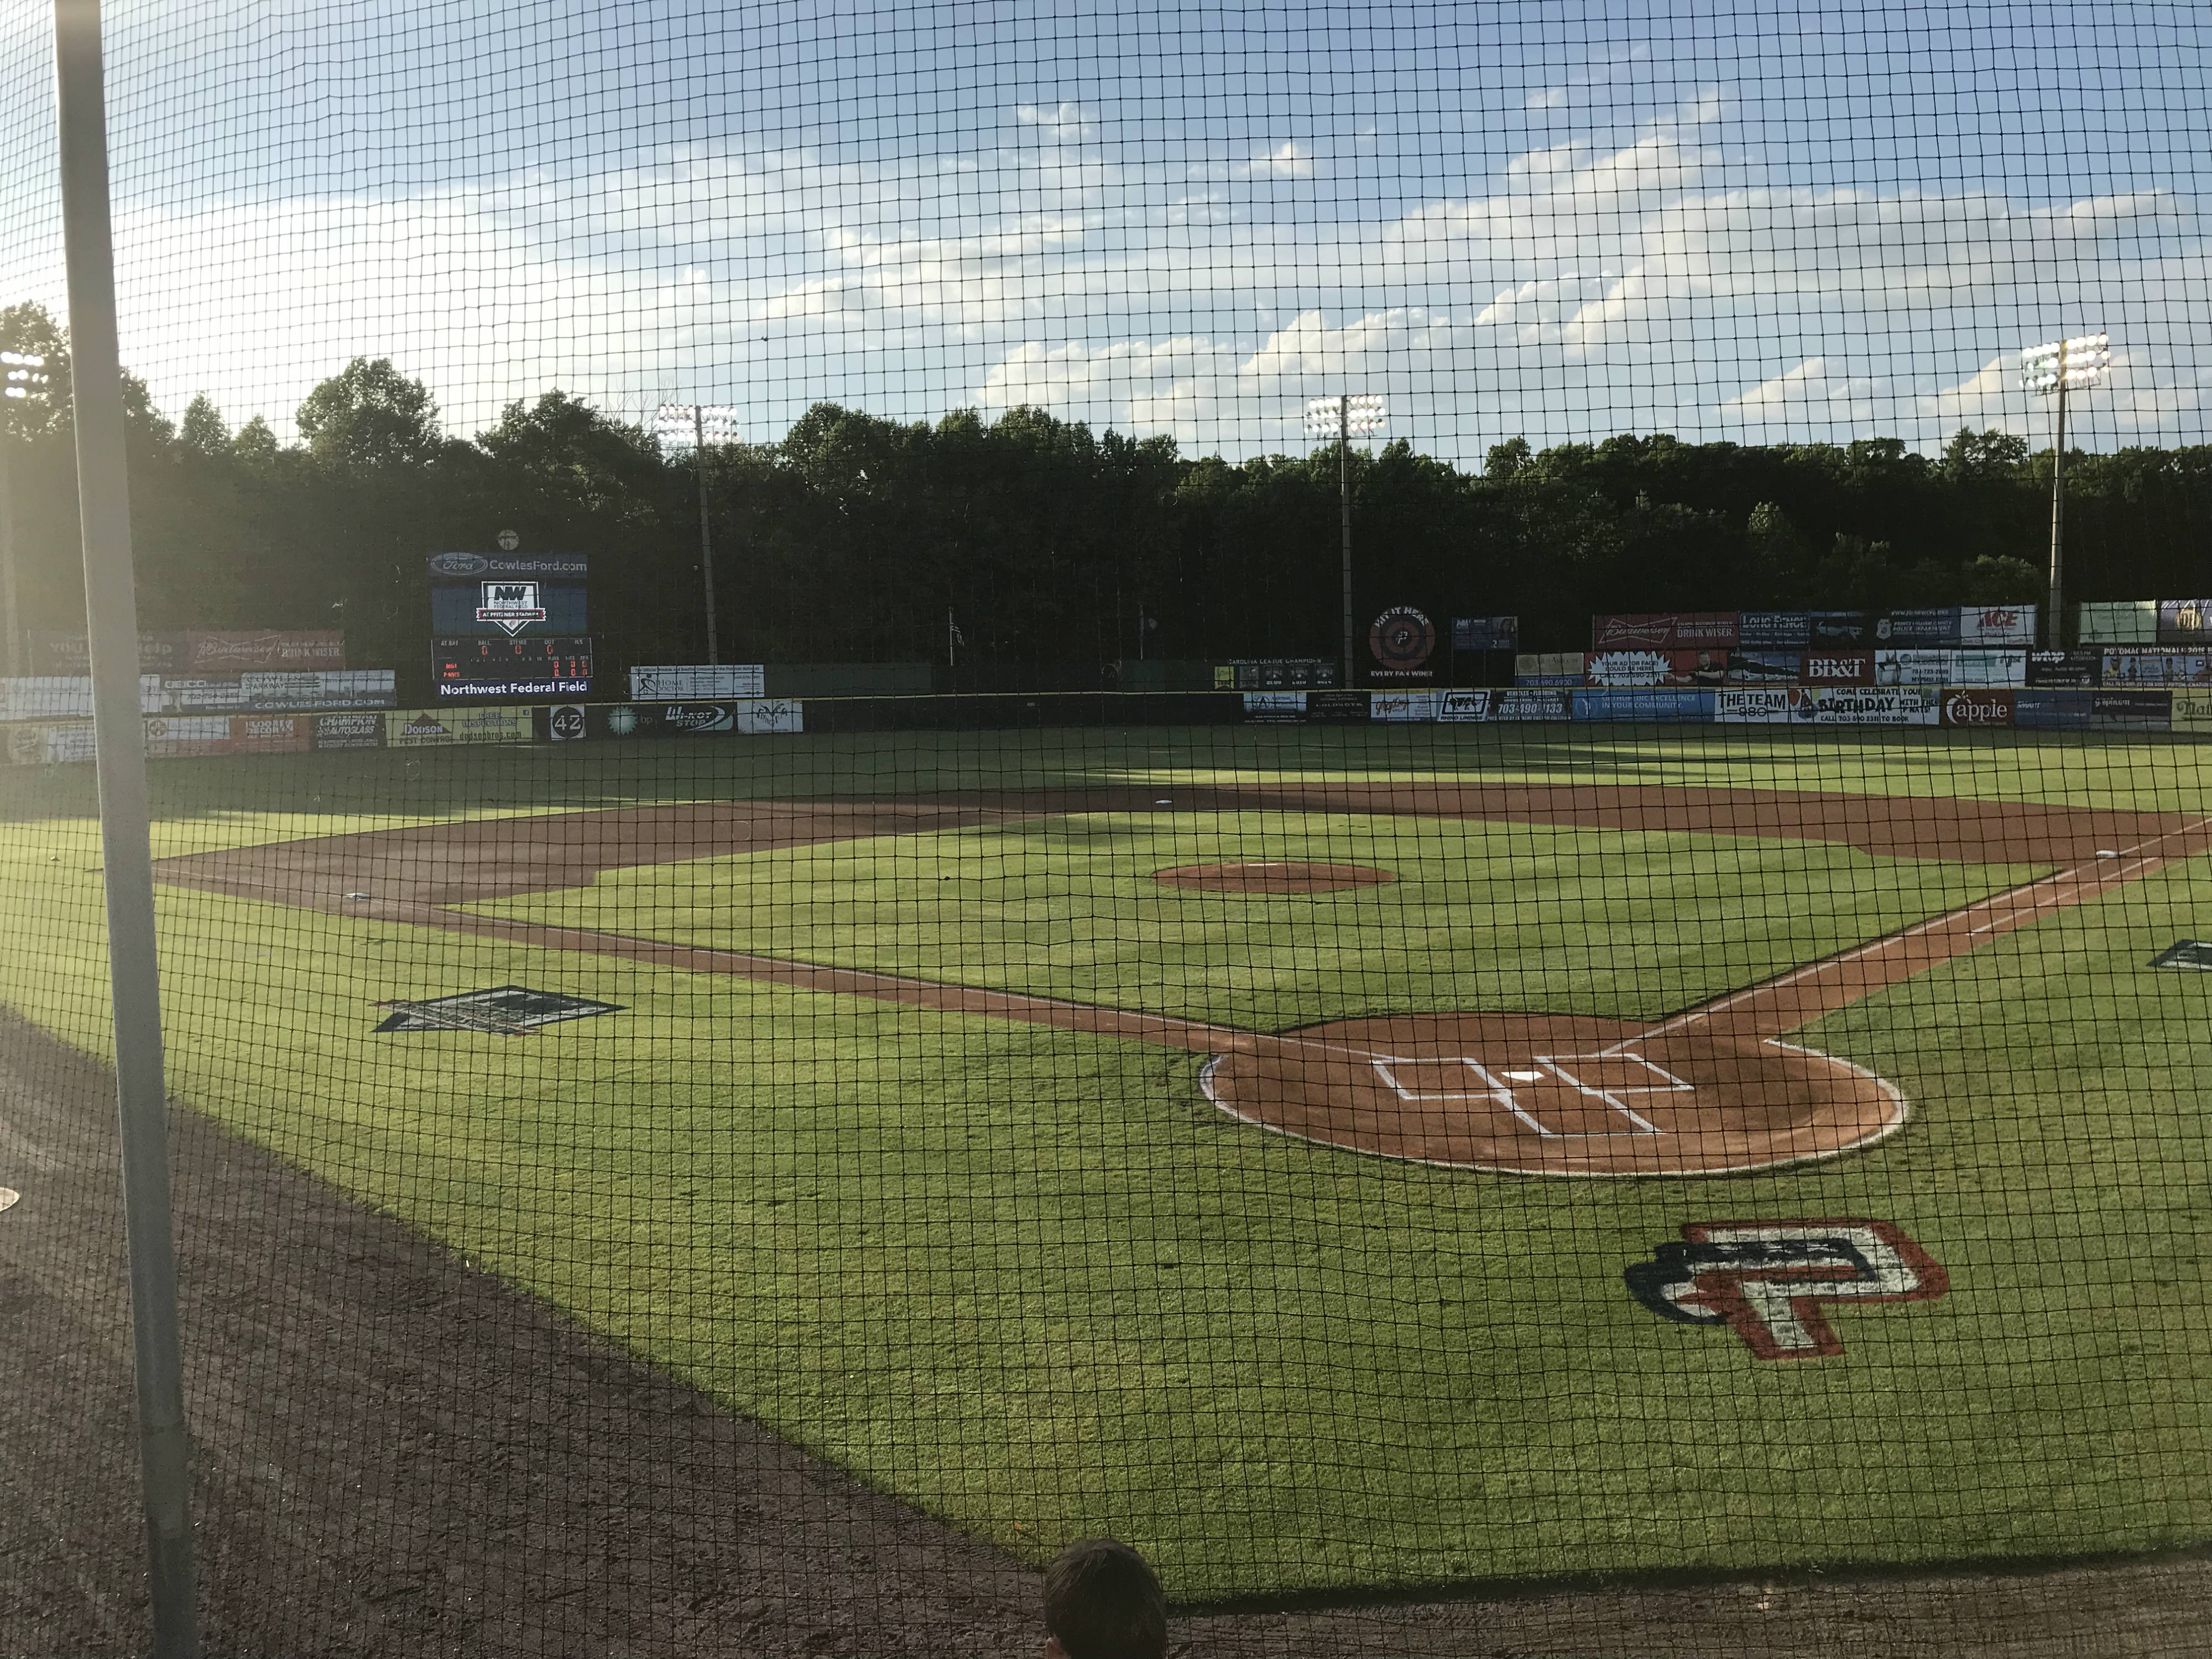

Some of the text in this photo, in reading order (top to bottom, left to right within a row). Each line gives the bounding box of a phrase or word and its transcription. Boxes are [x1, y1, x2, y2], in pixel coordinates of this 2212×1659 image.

[443, 560, 474, 570] Ford
[490, 560, 587, 571] CowlesFord.com
[1374, 612, 1390, 627] HIT
[1404, 607, 1429, 626] HERE
[1978, 608, 2019, 627] ACE
[1605, 624, 1670, 636] Budweiser
[1677, 628, 1705, 638] DRINK
[282, 646, 341, 658] DRINK WISER
[482, 645, 488, 655] 0
[1808, 659, 1866, 677] BB&T
[165, 680, 207, 689] GEICO
[441, 681, 587, 695] Northwest Federal Field
[254, 700, 385, 709] COWLESFORD.COM
[1718, 693, 1786, 710] THE TEAM
[1818, 697, 1896, 713] BIRTHDAY
[1738, 707, 1767, 717] 980
[1956, 698, 2007, 722] apple
[320, 715, 377, 726] CHAMPION
[555, 715, 581, 730] 42
[640, 715, 653, 724] bp
[676, 719, 706, 727] STOP
[404, 723, 444, 734] DODSON
[460, 731, 522, 740] dodsonbros.com
